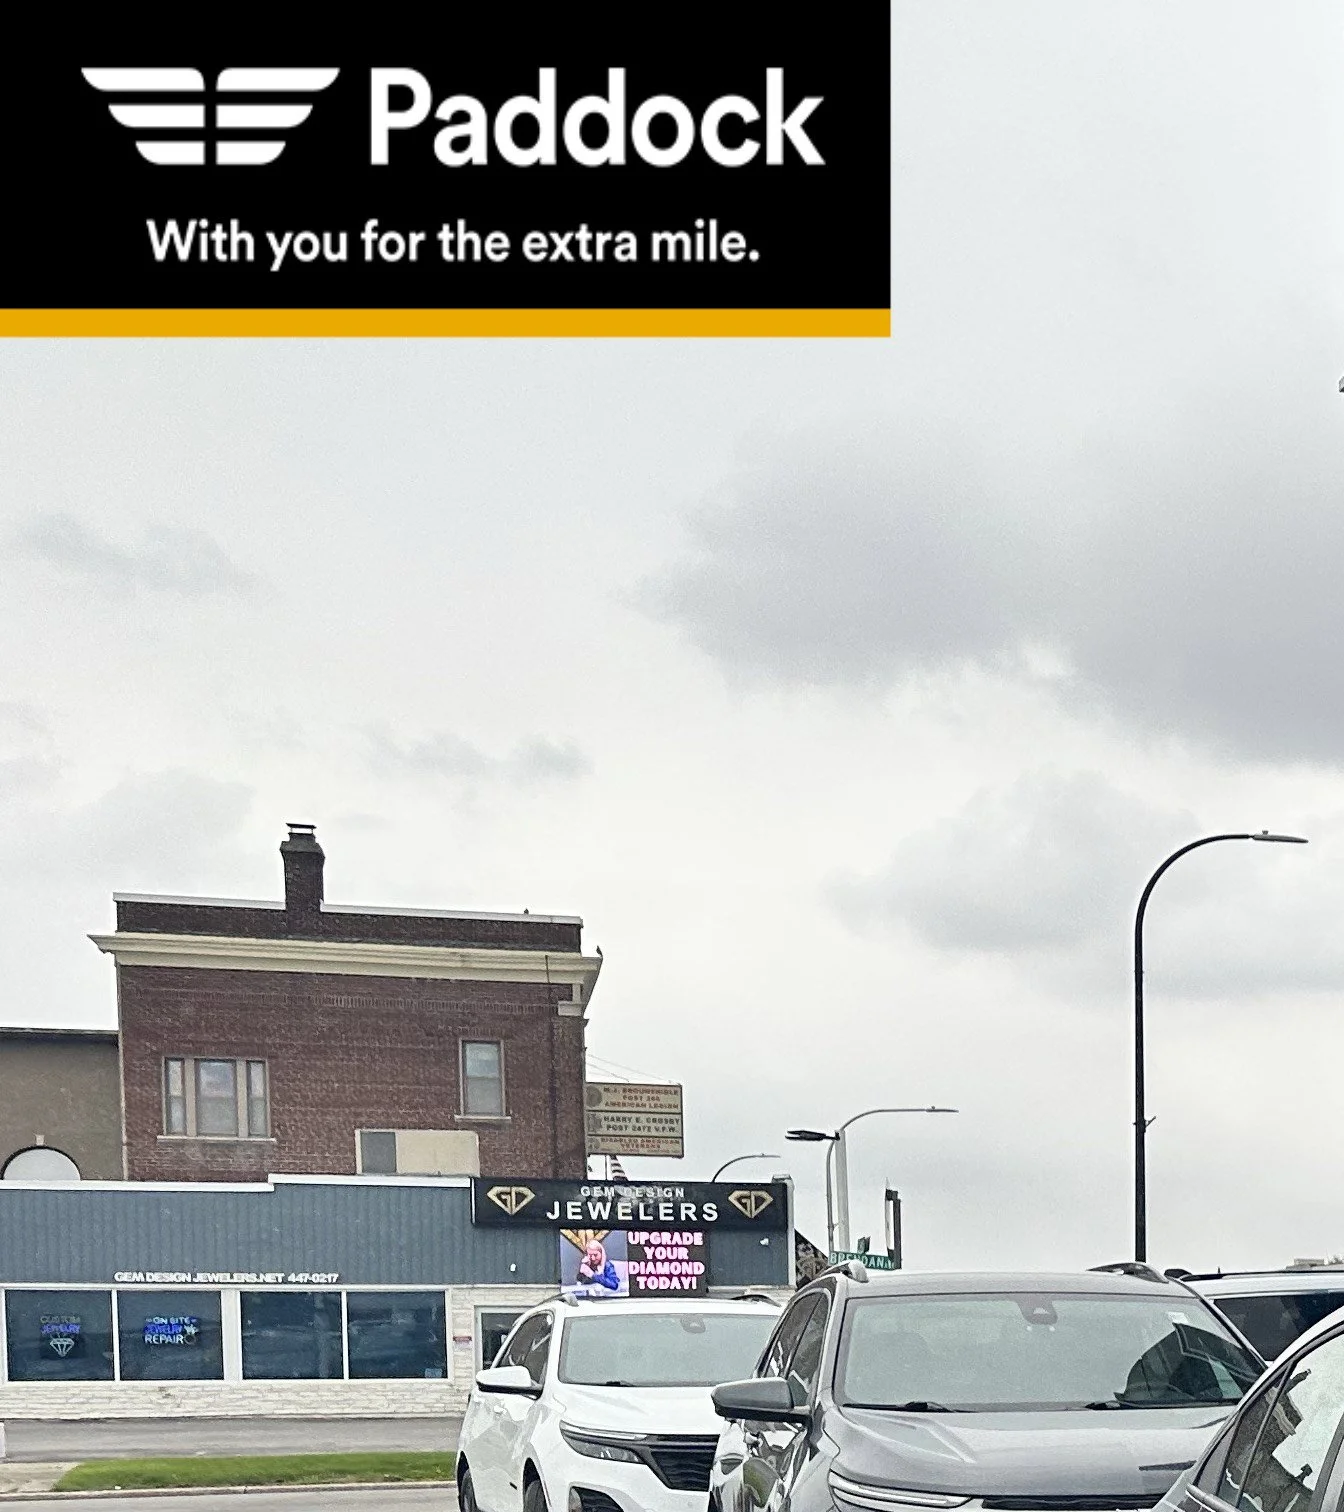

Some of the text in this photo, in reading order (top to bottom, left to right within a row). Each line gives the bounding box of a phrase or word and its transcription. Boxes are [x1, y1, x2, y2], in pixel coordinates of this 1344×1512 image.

[580, 1186, 685, 1199] GEM DESIGN
[546, 1201, 719, 1222] JEWELERS
[627, 1231, 704, 1246] UPGRADE
[644, 1246, 689, 1260] YOUR
[628, 1261, 705, 1275] DIAMOND
[114, 1272, 339, 1284] GEM DESIGN JEWELERS.NET 447-0217
[637, 1276, 698, 1290] TODAY!
[144, 1333, 184, 1345] REPAIR
